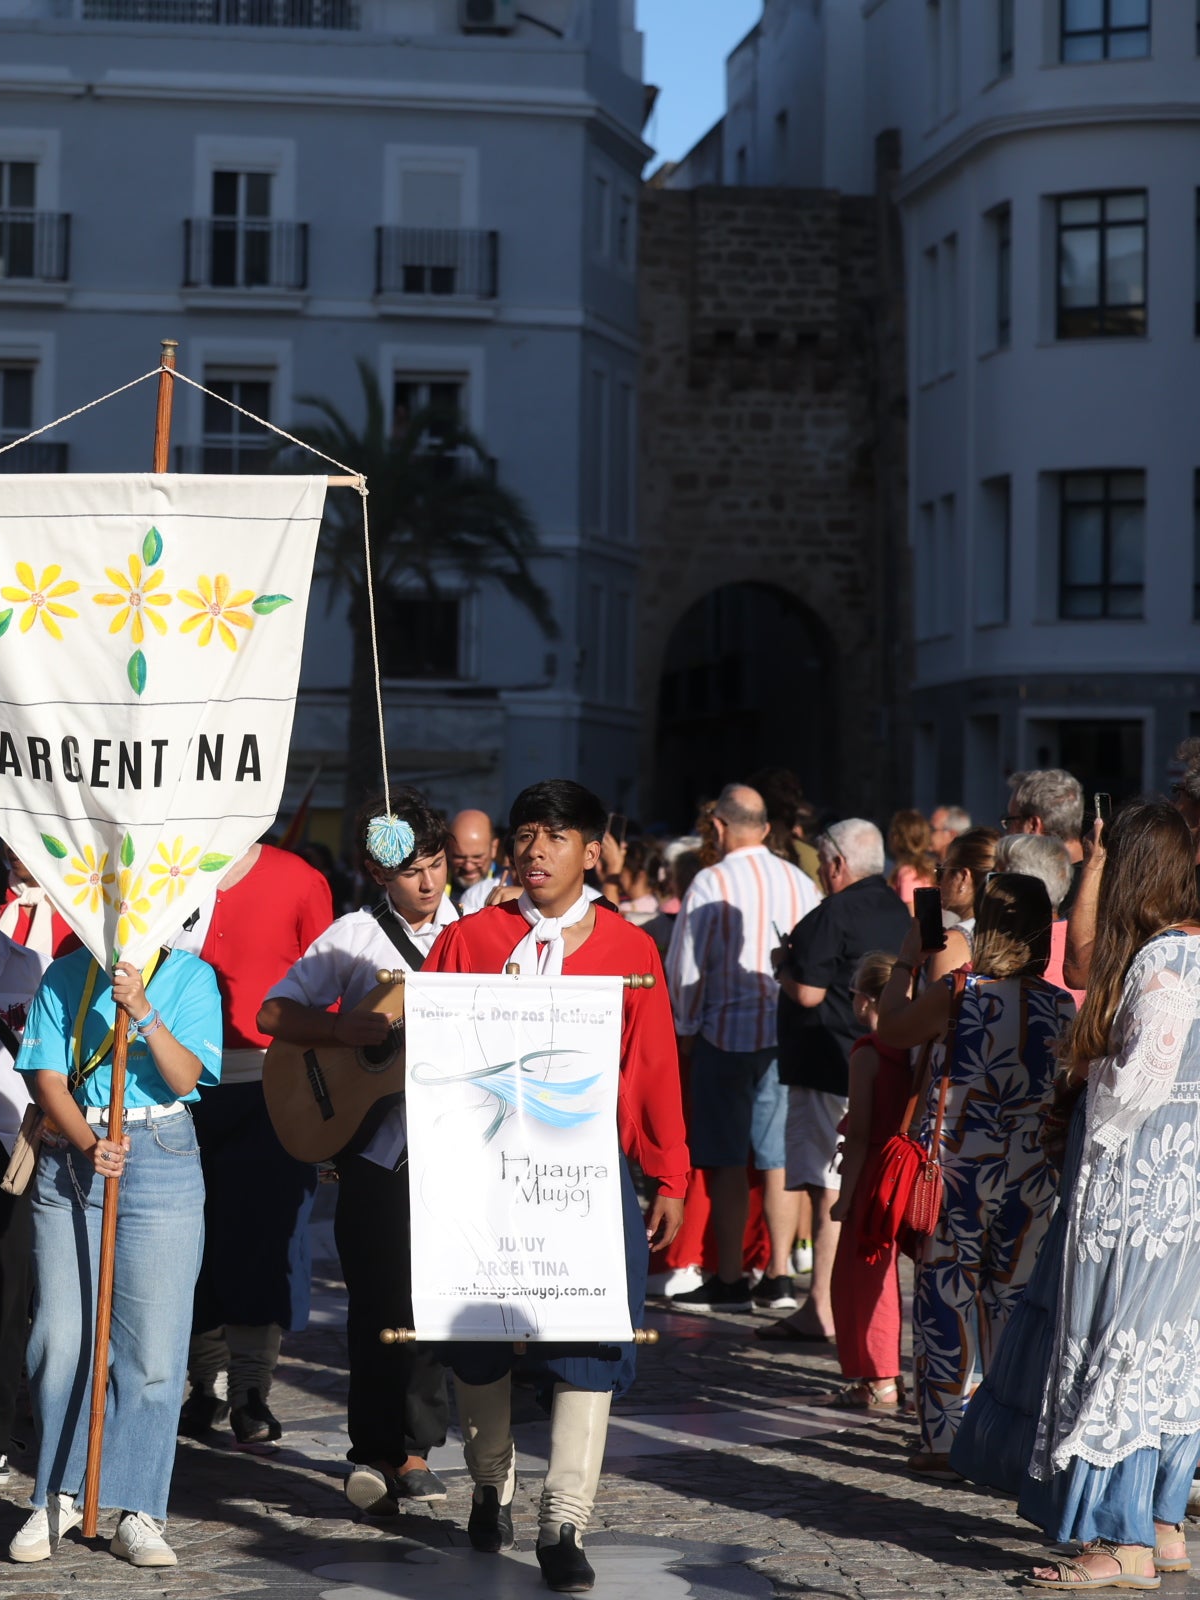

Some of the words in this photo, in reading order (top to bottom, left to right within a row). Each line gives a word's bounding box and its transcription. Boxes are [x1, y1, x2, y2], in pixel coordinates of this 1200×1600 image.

[467, 1006, 486, 1021] e
[501, 1150, 608, 1188] Huayra
[515, 1176, 591, 1218] Muyoj
[497, 1236, 546, 1253] JUUY
[439, 1282, 607, 1300] ww.huayramuyoj.com.ar
